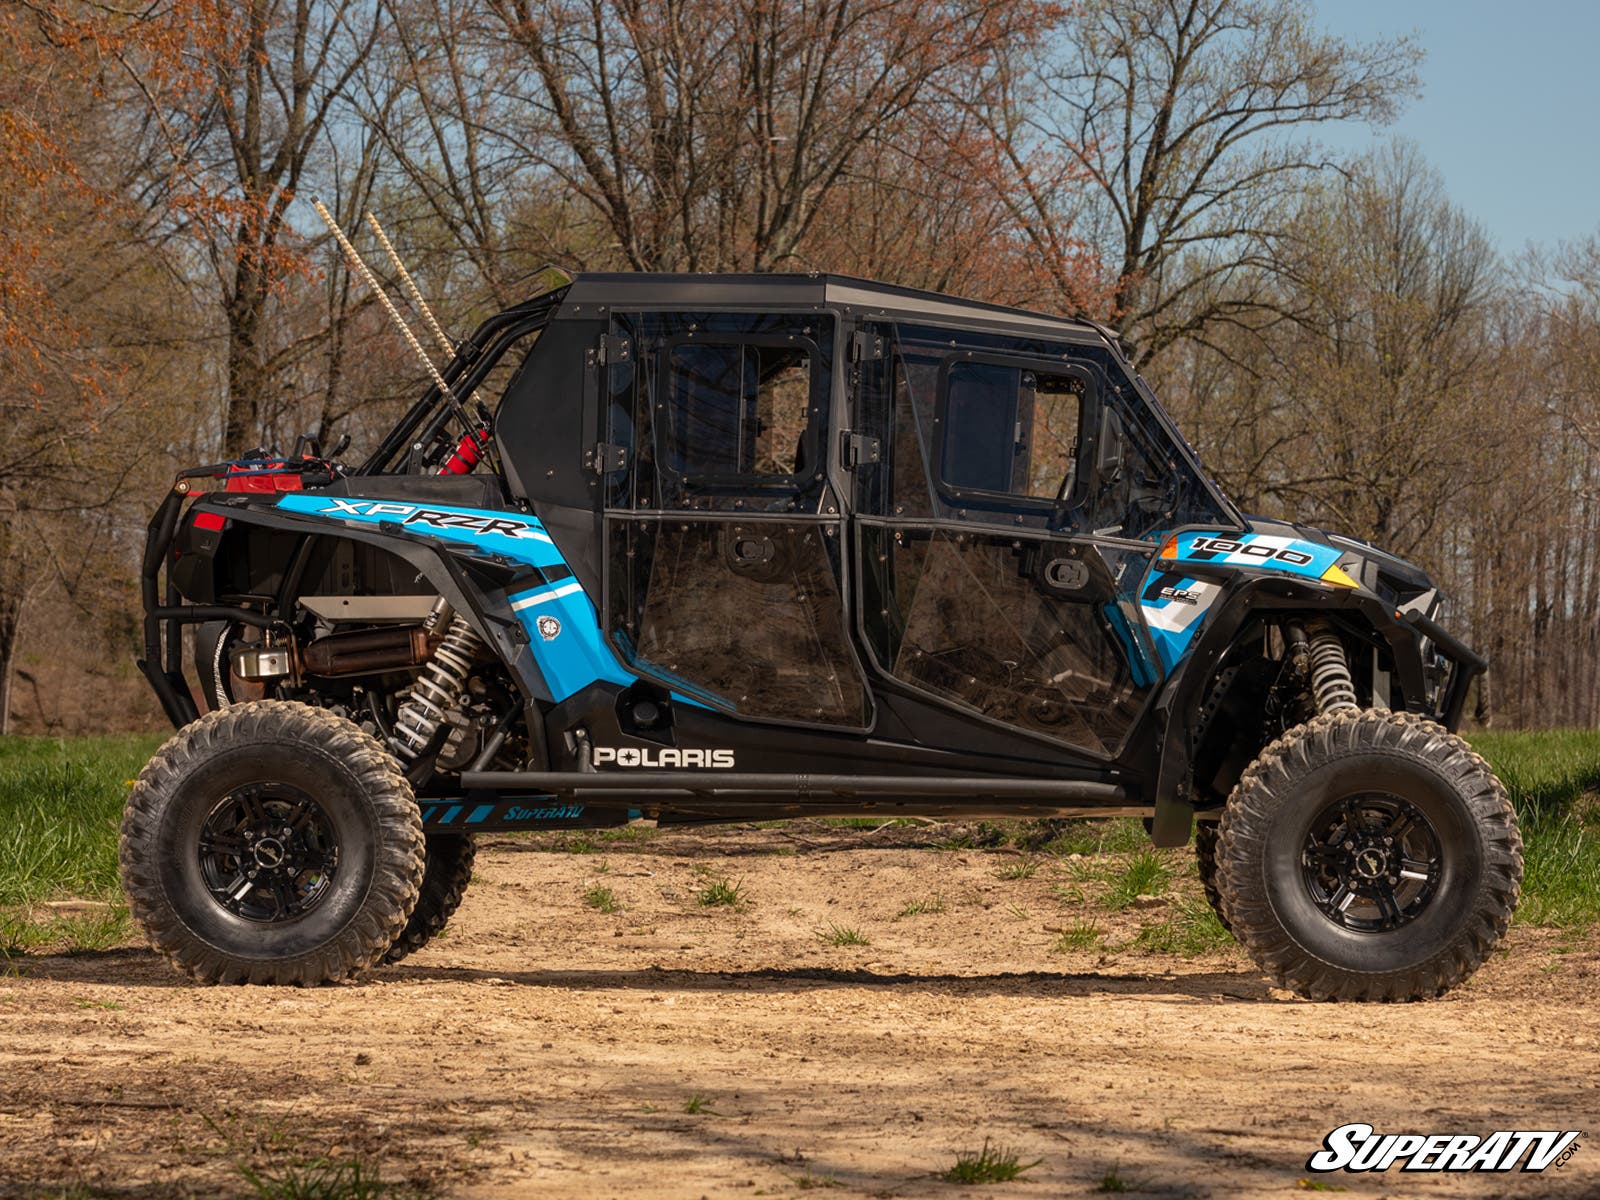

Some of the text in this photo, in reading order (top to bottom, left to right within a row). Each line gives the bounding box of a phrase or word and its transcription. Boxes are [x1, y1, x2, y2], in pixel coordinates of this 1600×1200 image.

[320, 499, 530, 538] XP RZR
[1190, 537, 1312, 566] 1000
[1160, 586, 1201, 600] EPS
[593, 747, 735, 768] POLARIS
